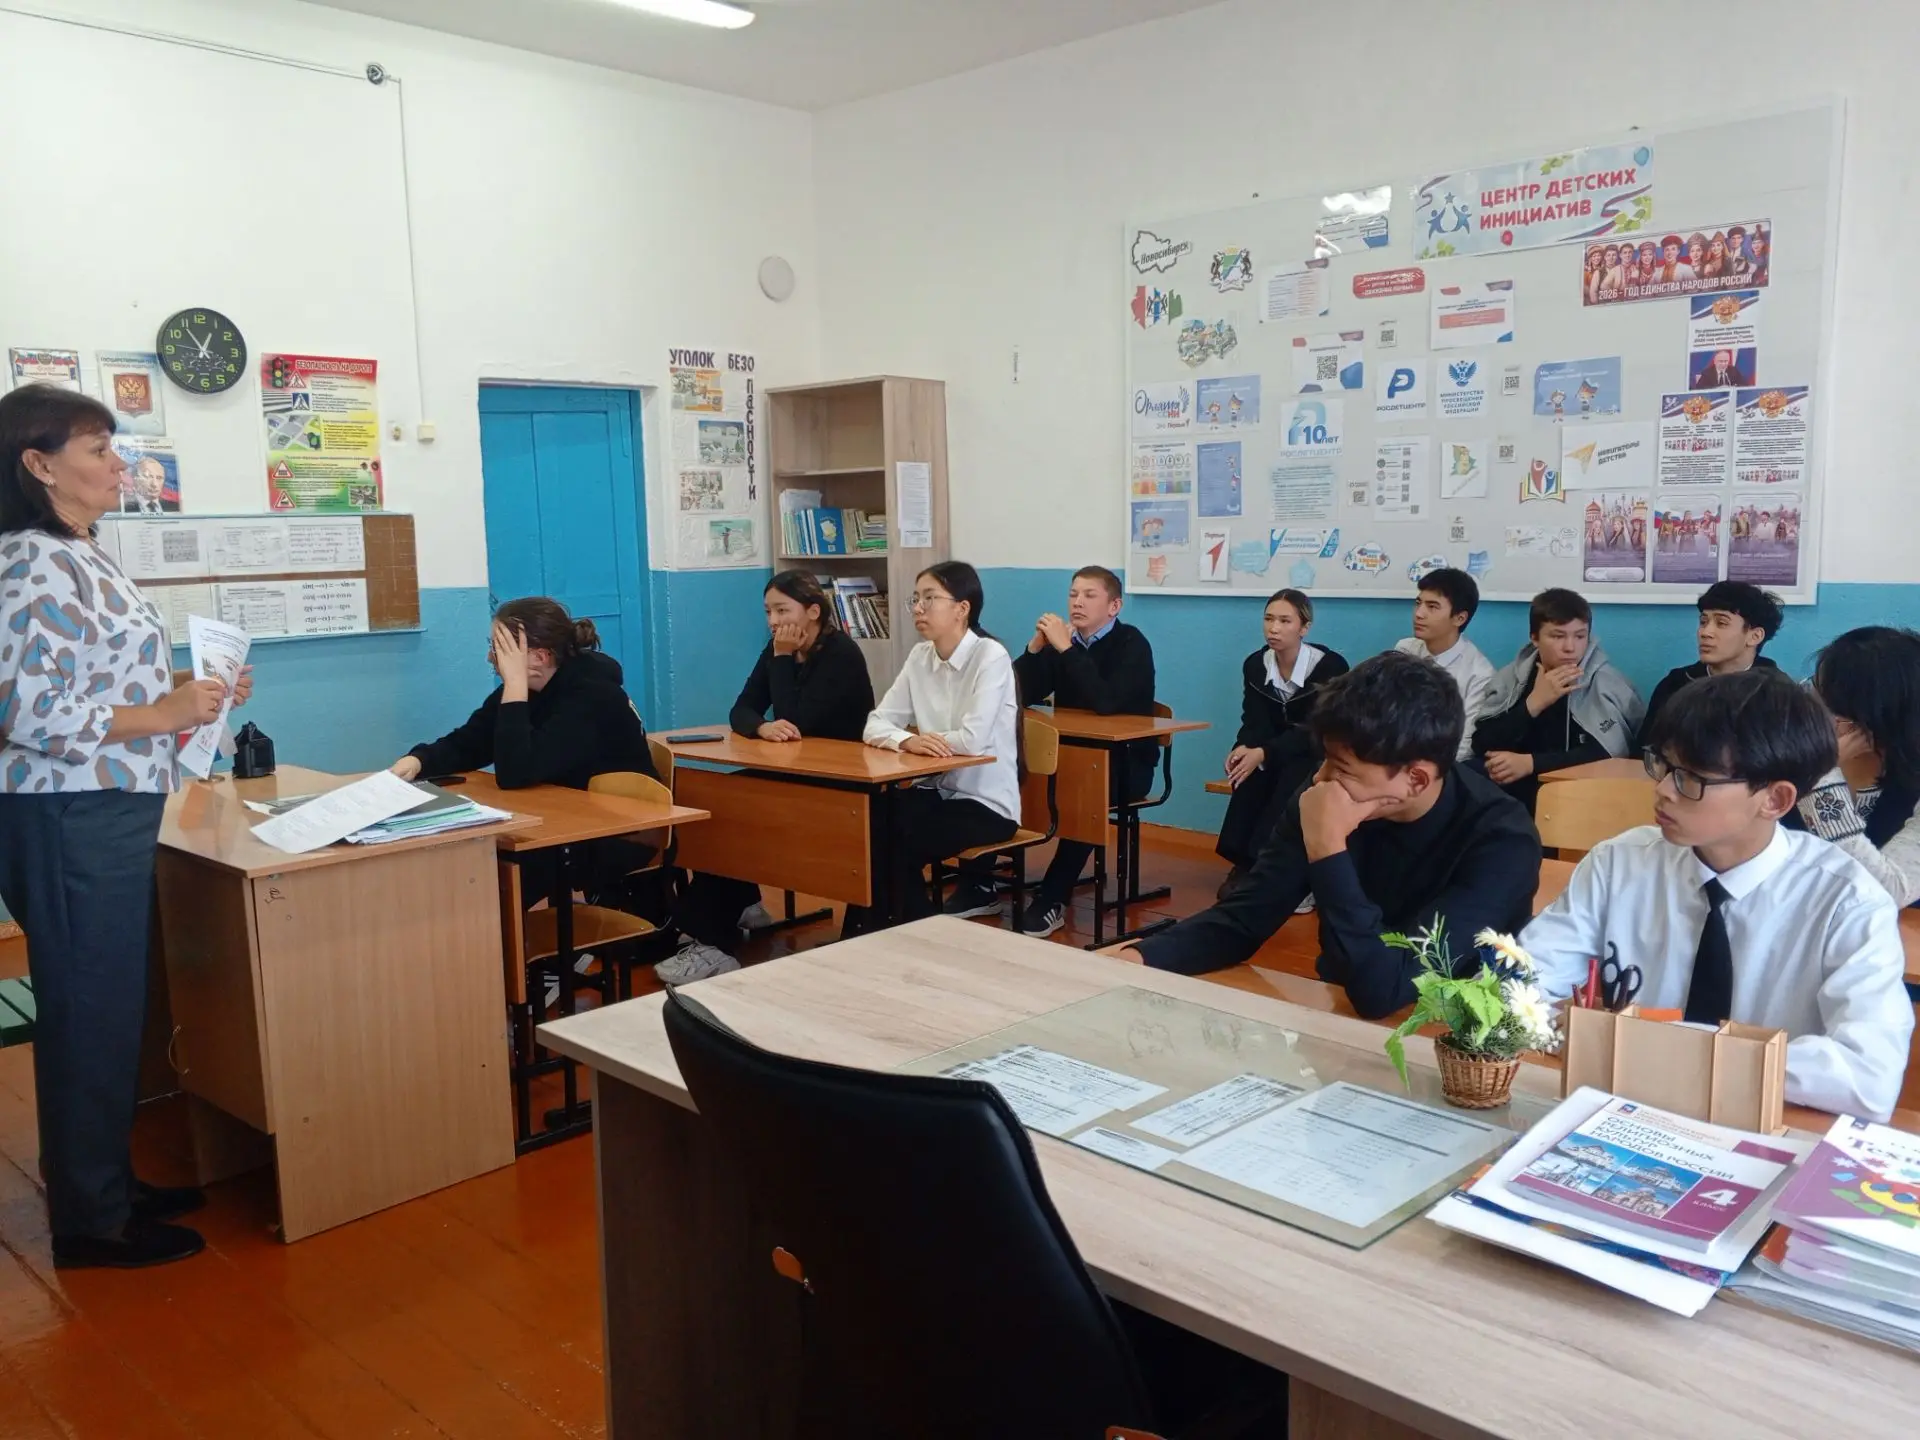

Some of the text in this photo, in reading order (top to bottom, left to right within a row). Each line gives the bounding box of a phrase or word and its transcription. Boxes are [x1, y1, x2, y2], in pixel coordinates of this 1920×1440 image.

[1480, 168, 1637, 208] ЦЕНТР ДЕТСКИХ
[1480, 199, 1592, 230] ИНИЦИАТИВ
[1140, 242, 1189, 265] Новосибирск
[1599, 289, 1618, 300] 2026
[1624, 286, 1640, 298] ГОД
[1640, 281, 1680, 296] ЕДИНСТВА
[1681, 277, 1719, 292] НАРОДОВ
[1720, 272, 1753, 287] РОССИИ
[193, 314, 207, 325] 12
[170, 328, 182, 340] 10
[222, 331, 233, 342] 2
[164, 344, 176, 356] 9
[230, 347, 240, 359] 3
[171, 360, 183, 373] 8
[668, 348, 755, 373] УГОЛОК БЕЗО
[225, 363, 237, 376] 4
[185, 373, 196, 385] 7
[199, 377, 211, 389] 6
[214, 374, 227, 386] 5
[1303, 425, 1327, 445] 10
[1595, 1125, 1659, 1149] КУЛЬТУР
[1607, 1116, 1676, 1142] ОСНОВЫ
[1601, 1121, 1715, 1161] РЕЛИГИОЗНЫХ
[1589, 1129, 1734, 1180] НАРОДОВ РОССИИ
[1697, 1188, 1738, 1207] 4
[1692, 1200, 1727, 1212] КЛАСС
